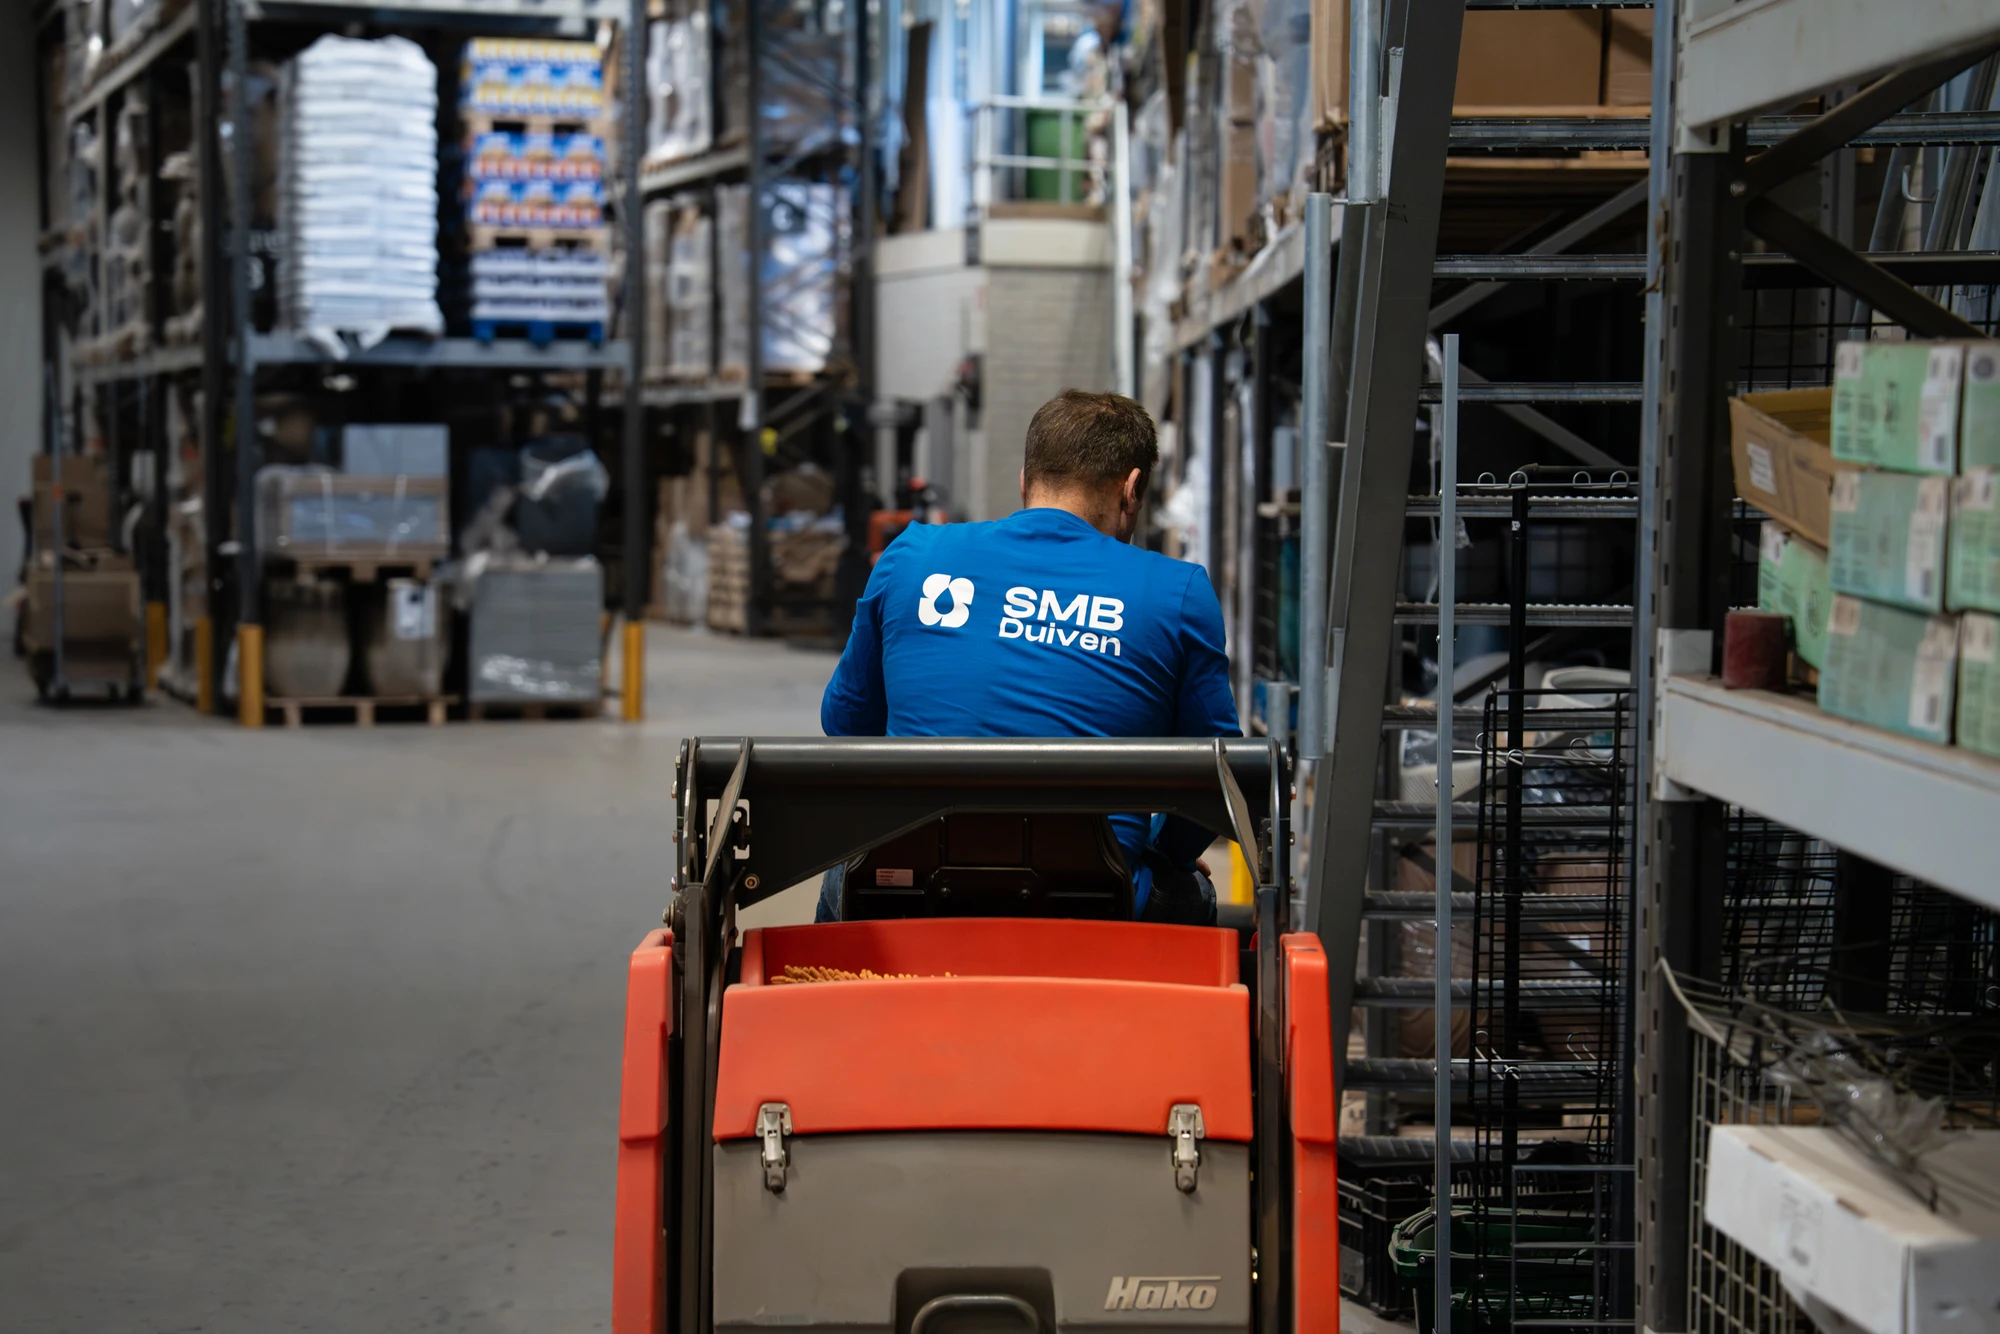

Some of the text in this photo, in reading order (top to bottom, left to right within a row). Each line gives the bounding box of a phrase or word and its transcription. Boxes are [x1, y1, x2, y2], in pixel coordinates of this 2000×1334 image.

[1003, 586, 1124, 631] SMB
[998, 617, 1120, 656] Duiven
[1104, 1276, 1218, 1310] Hako
